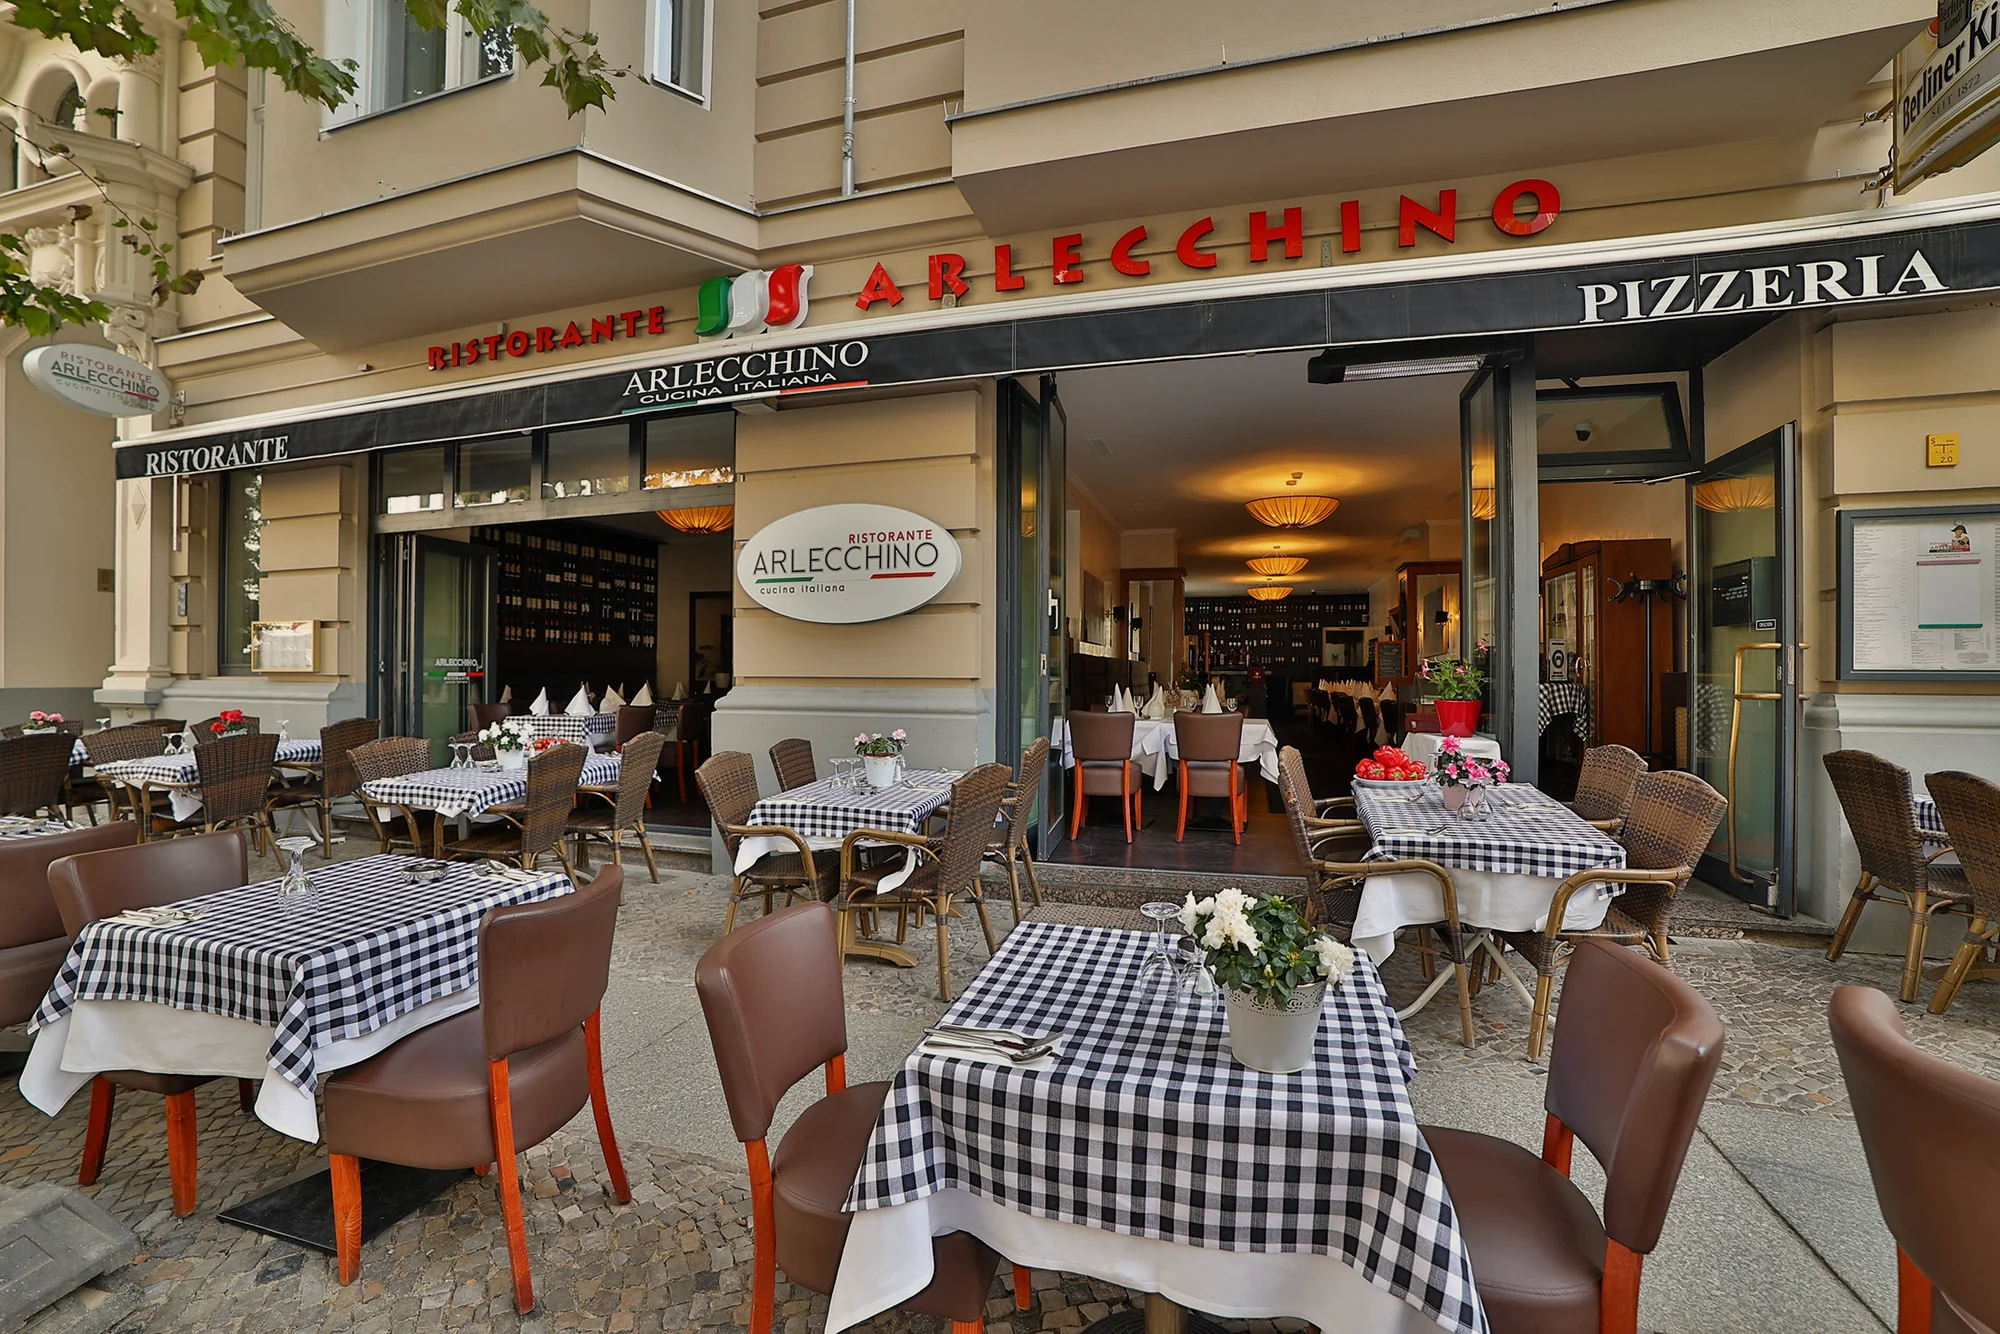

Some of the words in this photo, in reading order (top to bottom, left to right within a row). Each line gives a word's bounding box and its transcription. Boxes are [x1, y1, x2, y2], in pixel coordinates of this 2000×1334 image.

[1903, 40, 1966, 136] Berliner
[1931, 95, 1952, 119] SEIT
[1957, 73, 1981, 99] 1872
[855, 178, 1562, 312] ARLECCHINO
[1577, 250, 1950, 323] PIZZERIA
[428, 305, 665, 371] RISTORANTE
[51, 360, 160, 398] ARLECCHINO
[60, 350, 153, 384] RISTORANTE
[622, 341, 869, 396] ARLECCHINO
[56, 378, 101, 396] cucina
[640, 386, 722, 404] CUCINA
[734, 372, 837, 393] ITALIANA
[145, 435, 289, 476] RISTORANTE
[1930, 437, 1936, 445] S
[848, 529, 933, 544] RISTORANTE
[753, 541, 939, 575] ARLECCHINO
[760, 585, 795, 595] cucina
[801, 583, 845, 593] italiana
[435, 657, 478, 667] ARLECCHINO
